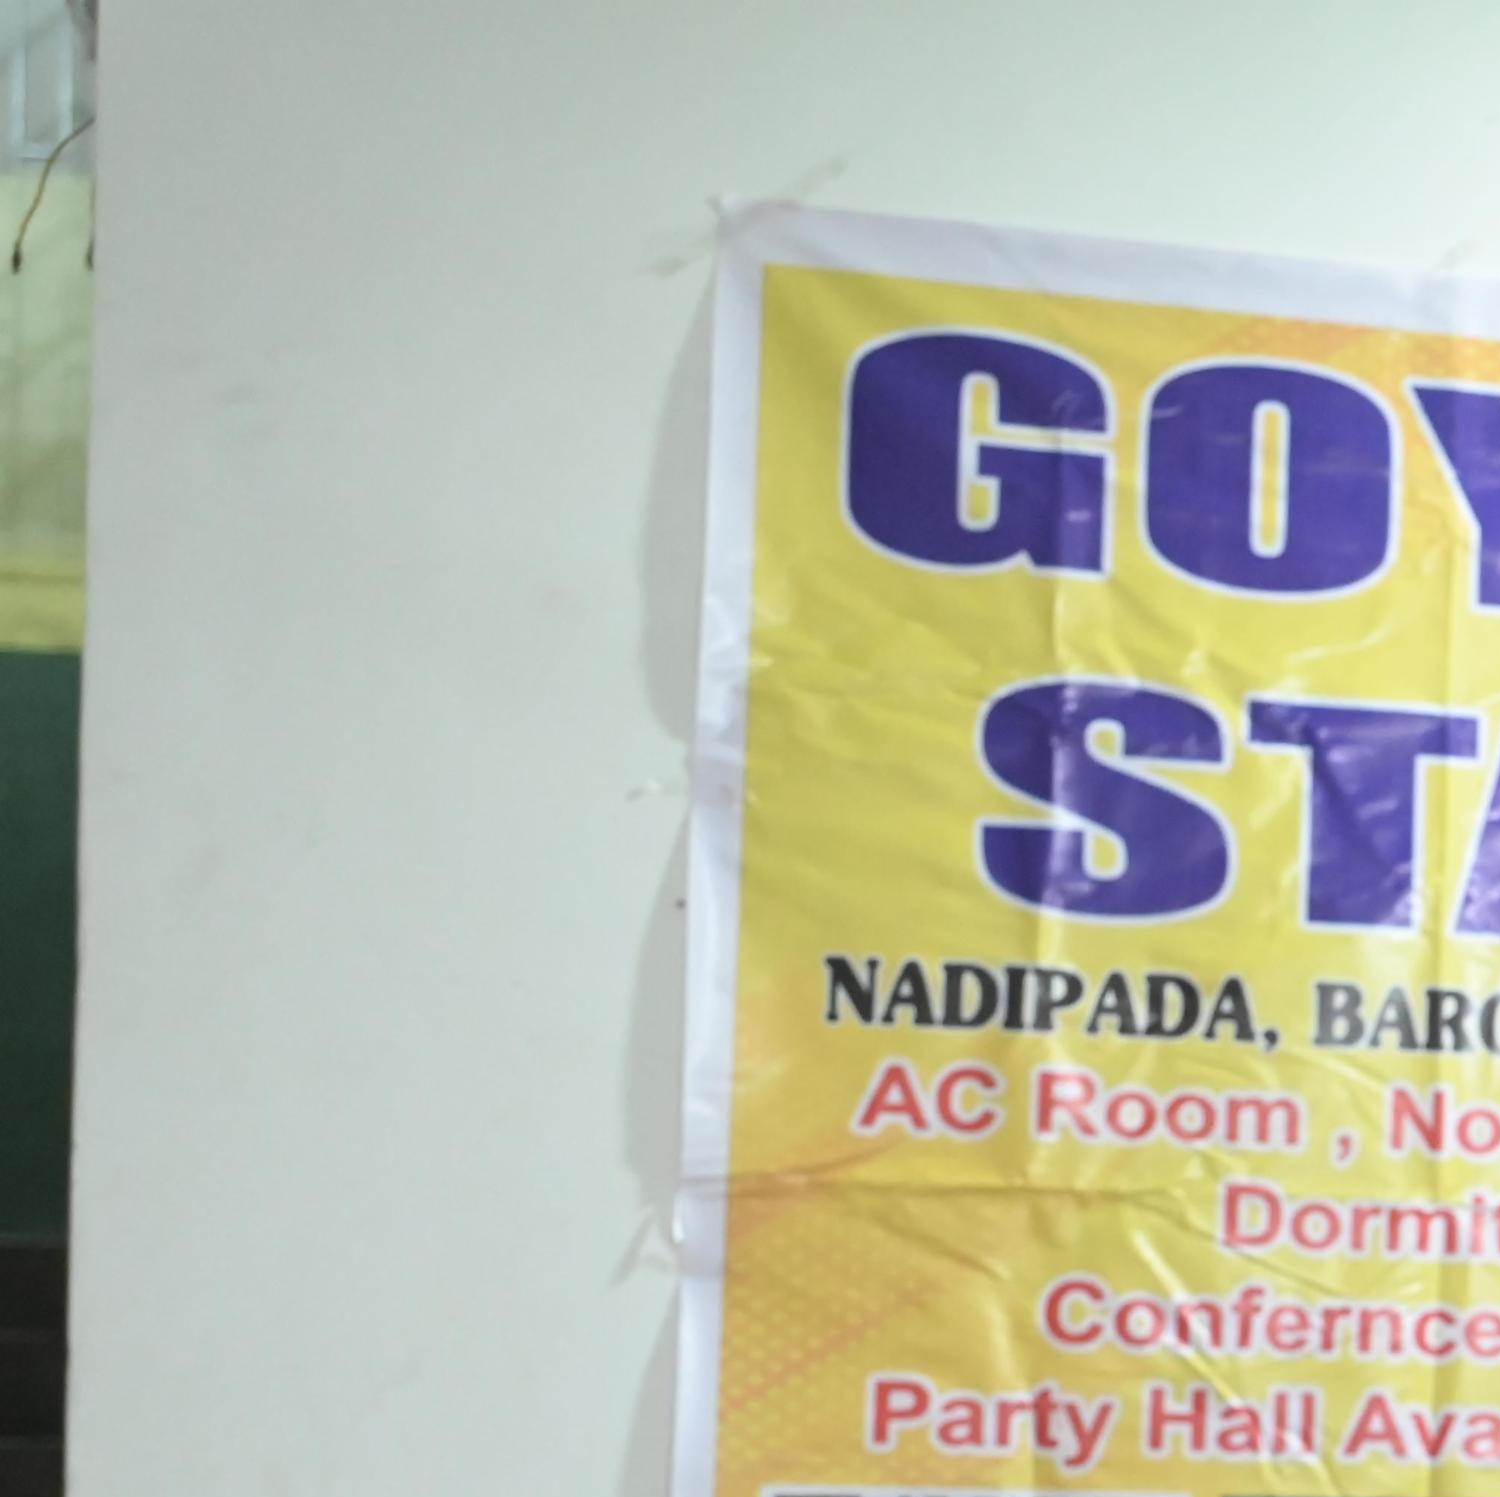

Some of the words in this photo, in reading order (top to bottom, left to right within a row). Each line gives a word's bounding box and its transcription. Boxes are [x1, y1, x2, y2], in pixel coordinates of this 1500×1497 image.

[823, 956, 1279, 1052] NADIPADA,
[858, 1064, 998, 1133] AC
[1036, 1071, 1300, 1146] Room
[871, 1378, 1113, 1468] Party
[1148, 1386, 1317, 1455] Hall
